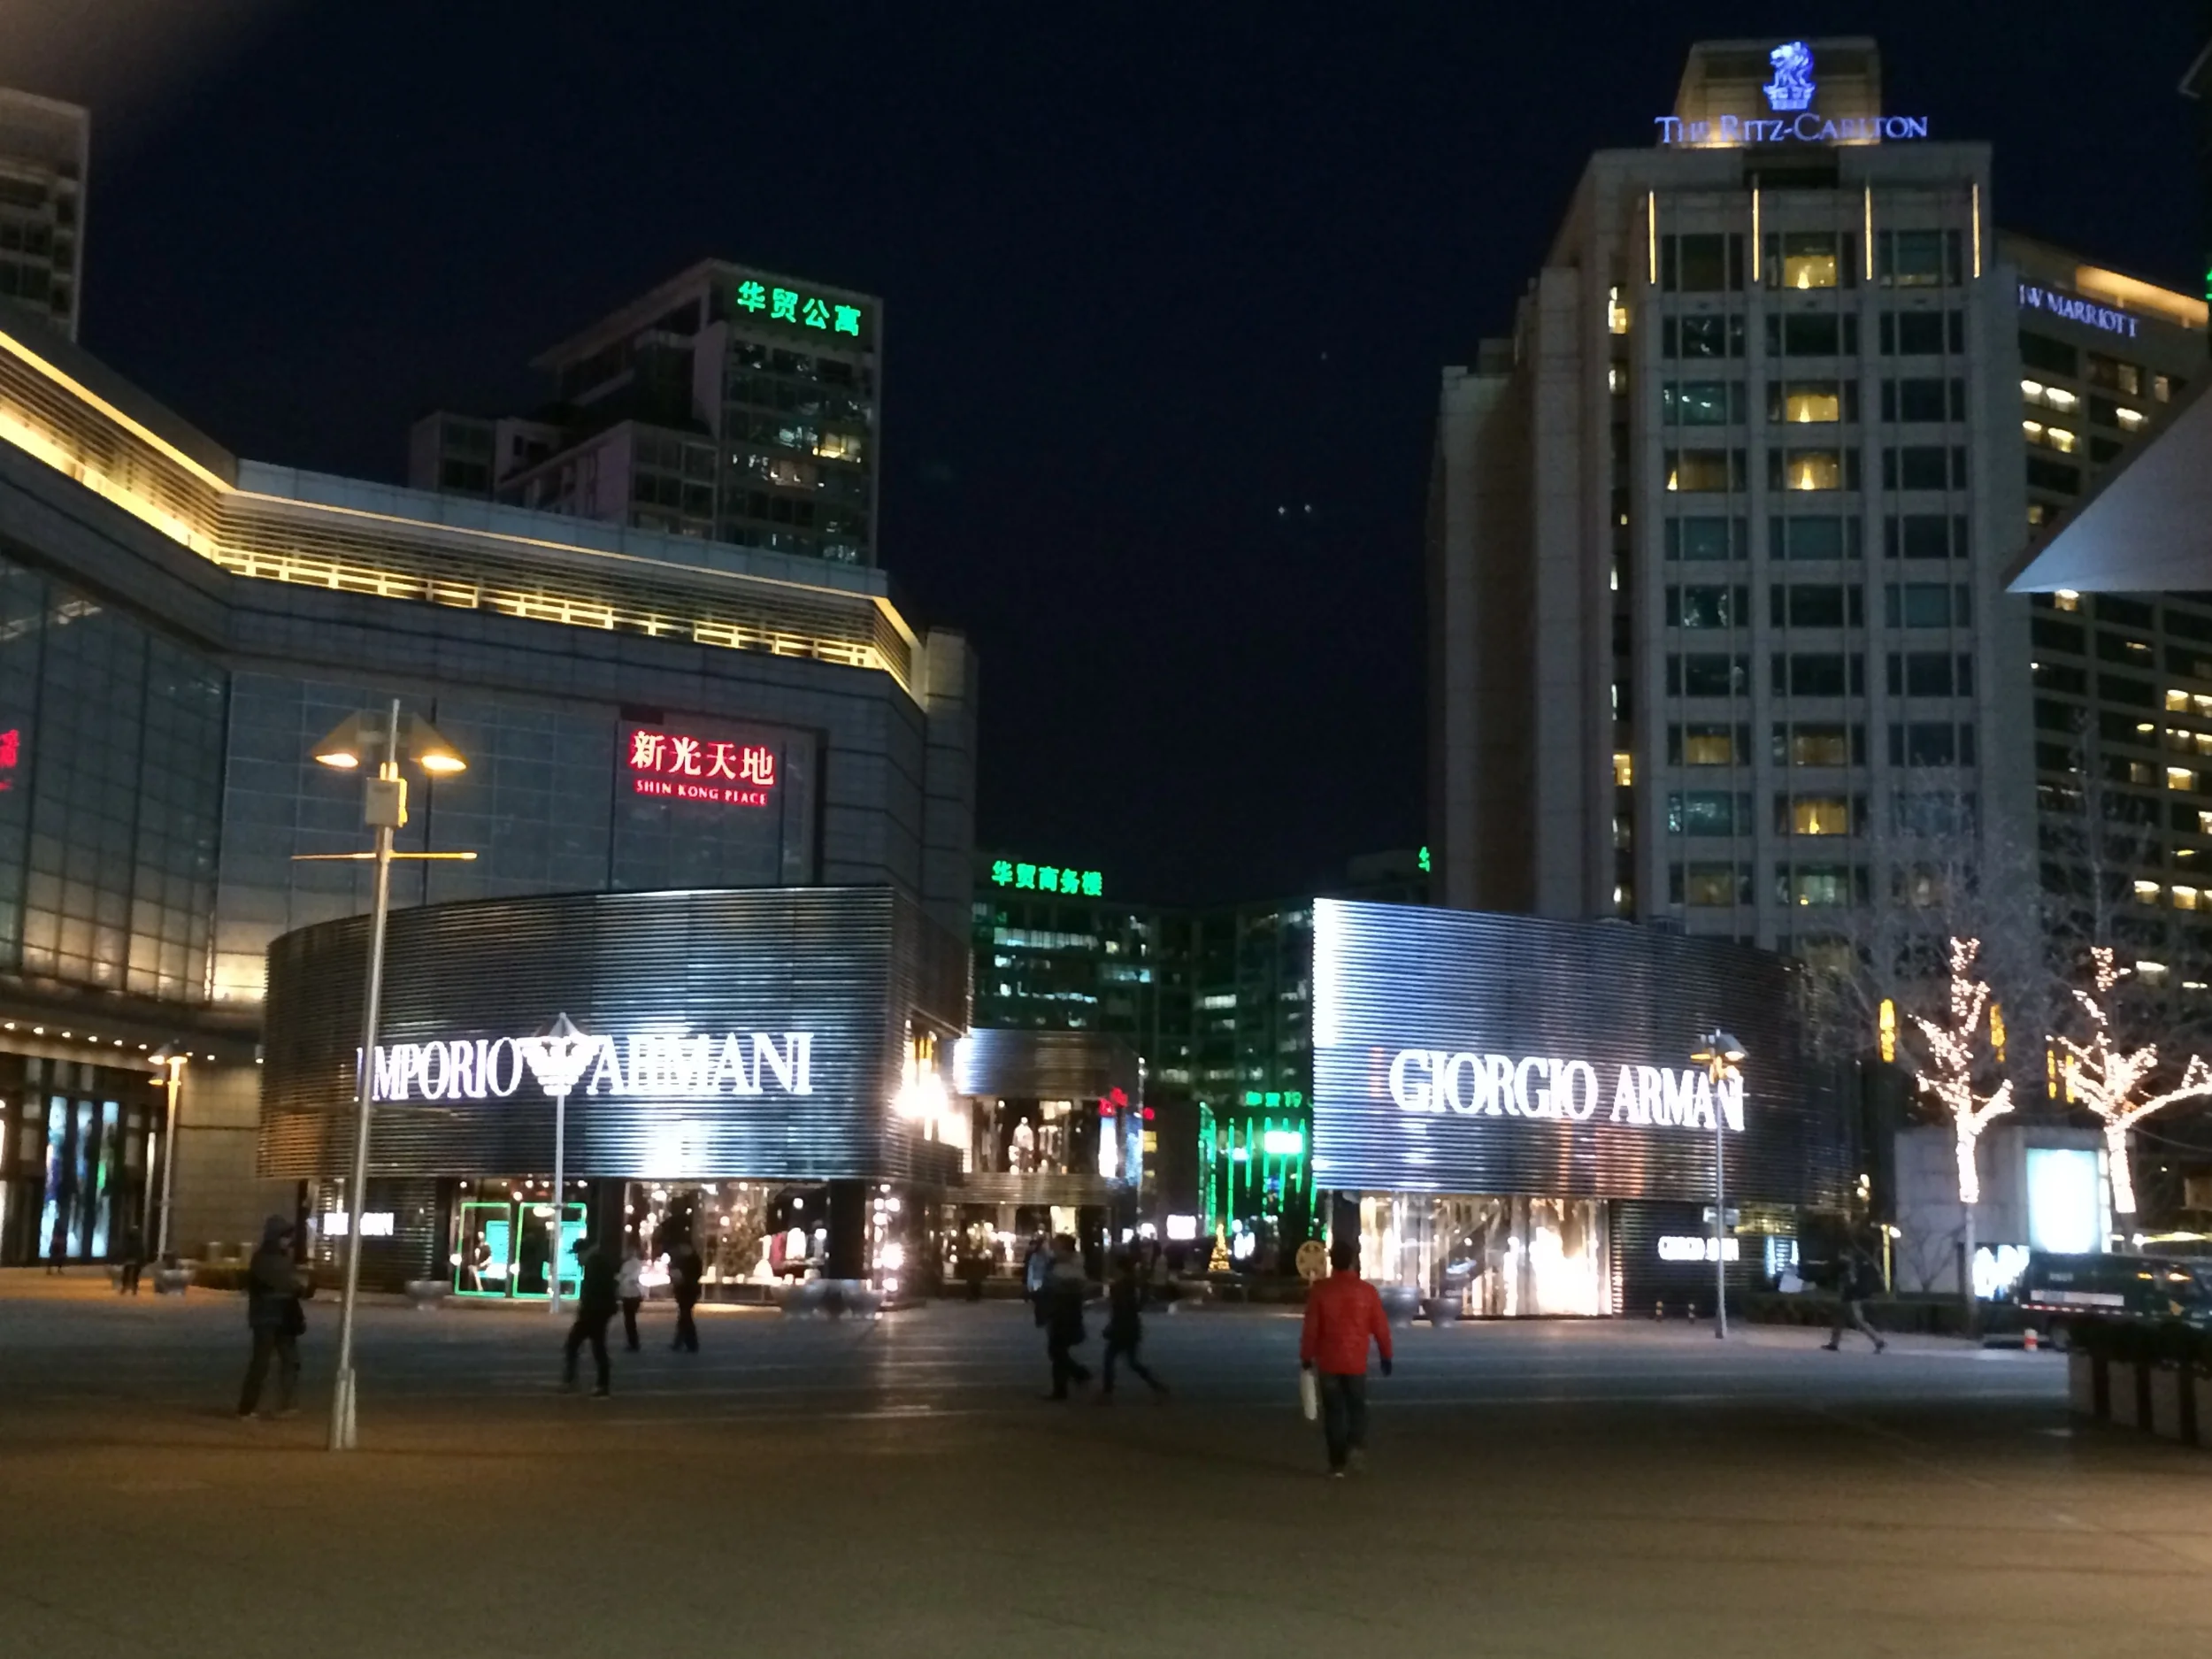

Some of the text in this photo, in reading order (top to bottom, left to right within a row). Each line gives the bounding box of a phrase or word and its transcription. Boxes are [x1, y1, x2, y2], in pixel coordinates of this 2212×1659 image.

[1719, 112, 1928, 142] RITZ-CARLTON
[736, 280, 862, 337] 华贸公寓
[2046, 291, 2139, 338] MARRIOTT
[629, 729, 775, 786] 新光天地
[636, 780, 768, 806] SHIN KONG PLACE
[1388, 1048, 1599, 1121] GIORGIO
